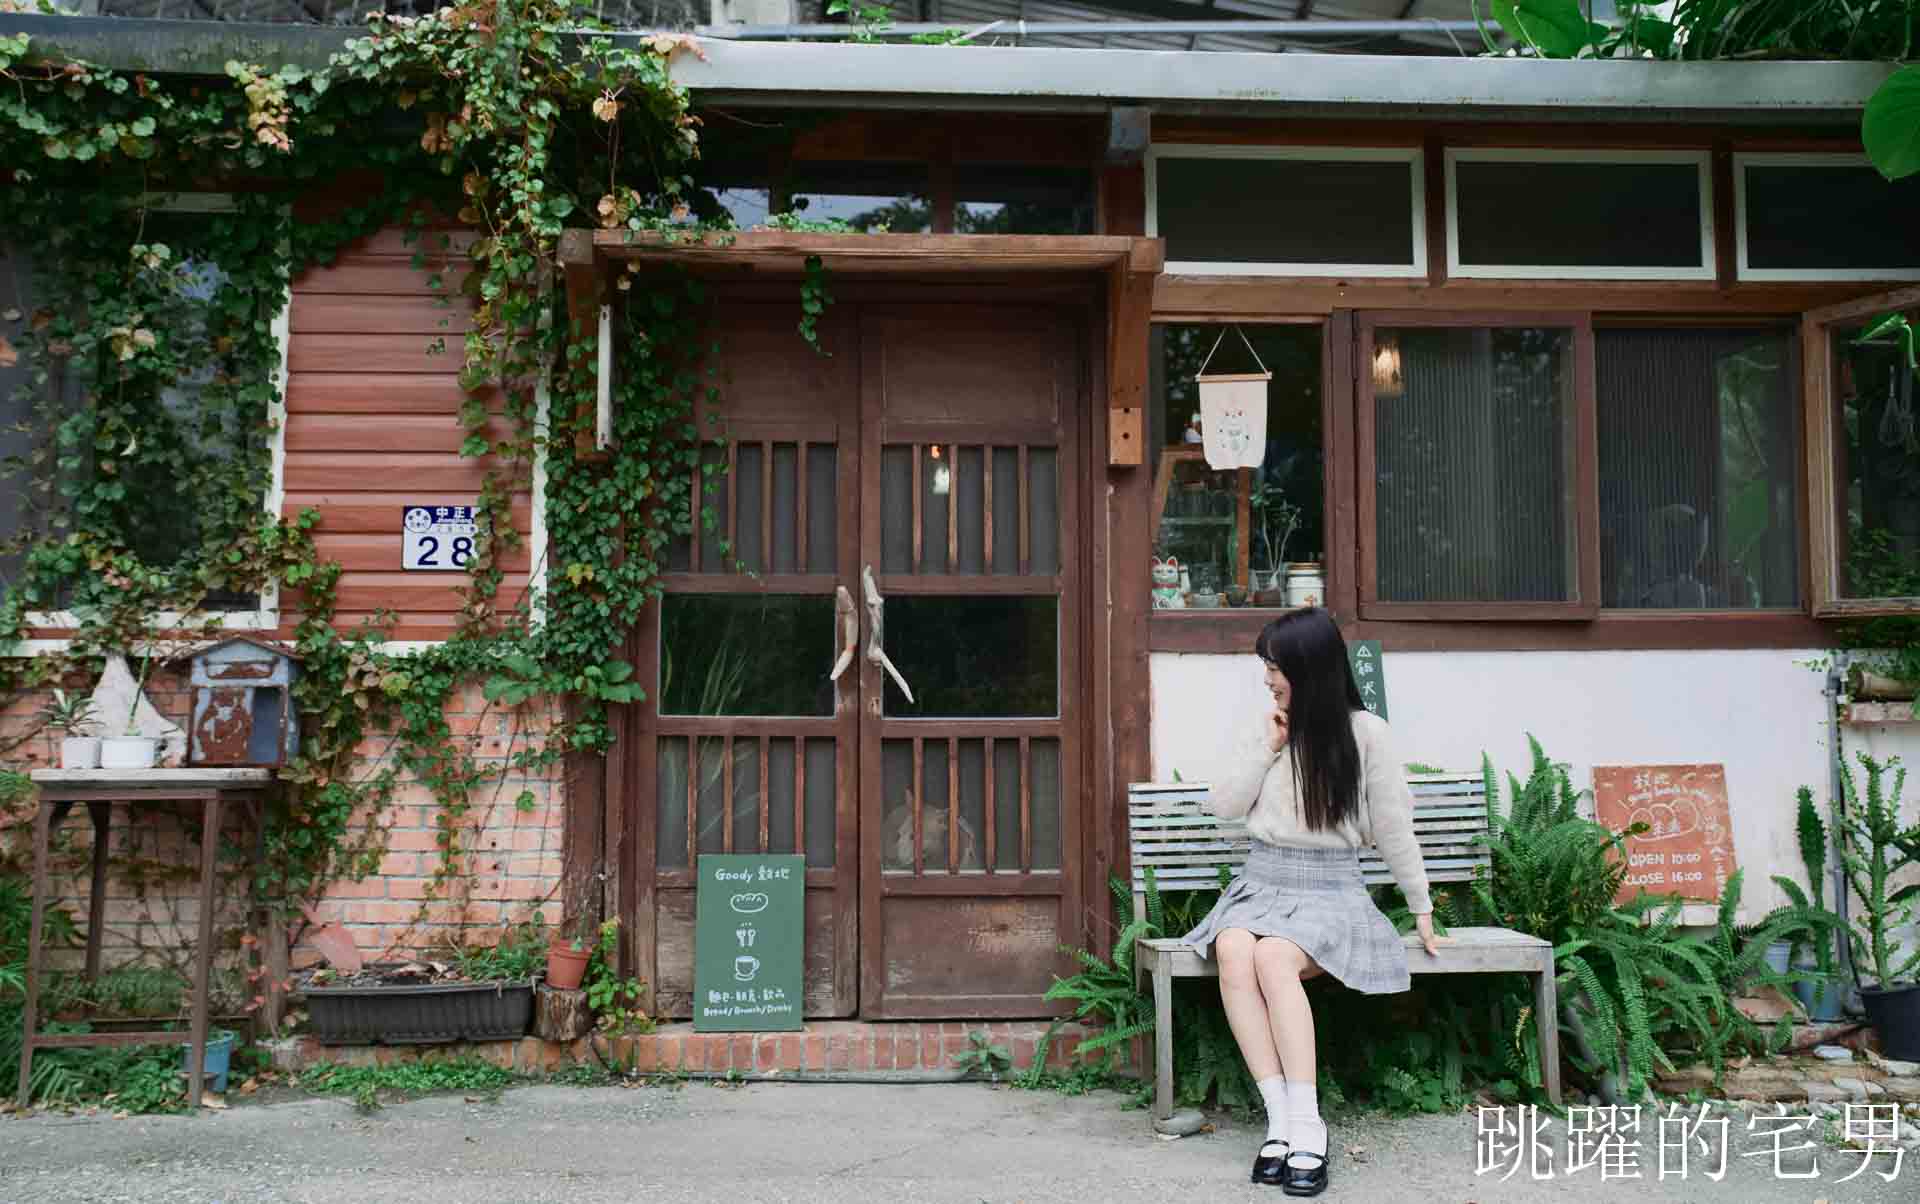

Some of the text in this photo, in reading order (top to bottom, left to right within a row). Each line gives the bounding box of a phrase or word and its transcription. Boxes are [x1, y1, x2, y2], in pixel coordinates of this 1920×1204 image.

[417, 536, 473, 567] 28
[1629, 853, 1702, 866] OPEN 10:00
[715, 867, 753, 883] Goody
[1625, 871, 1704, 886] CLOSE 16:00
